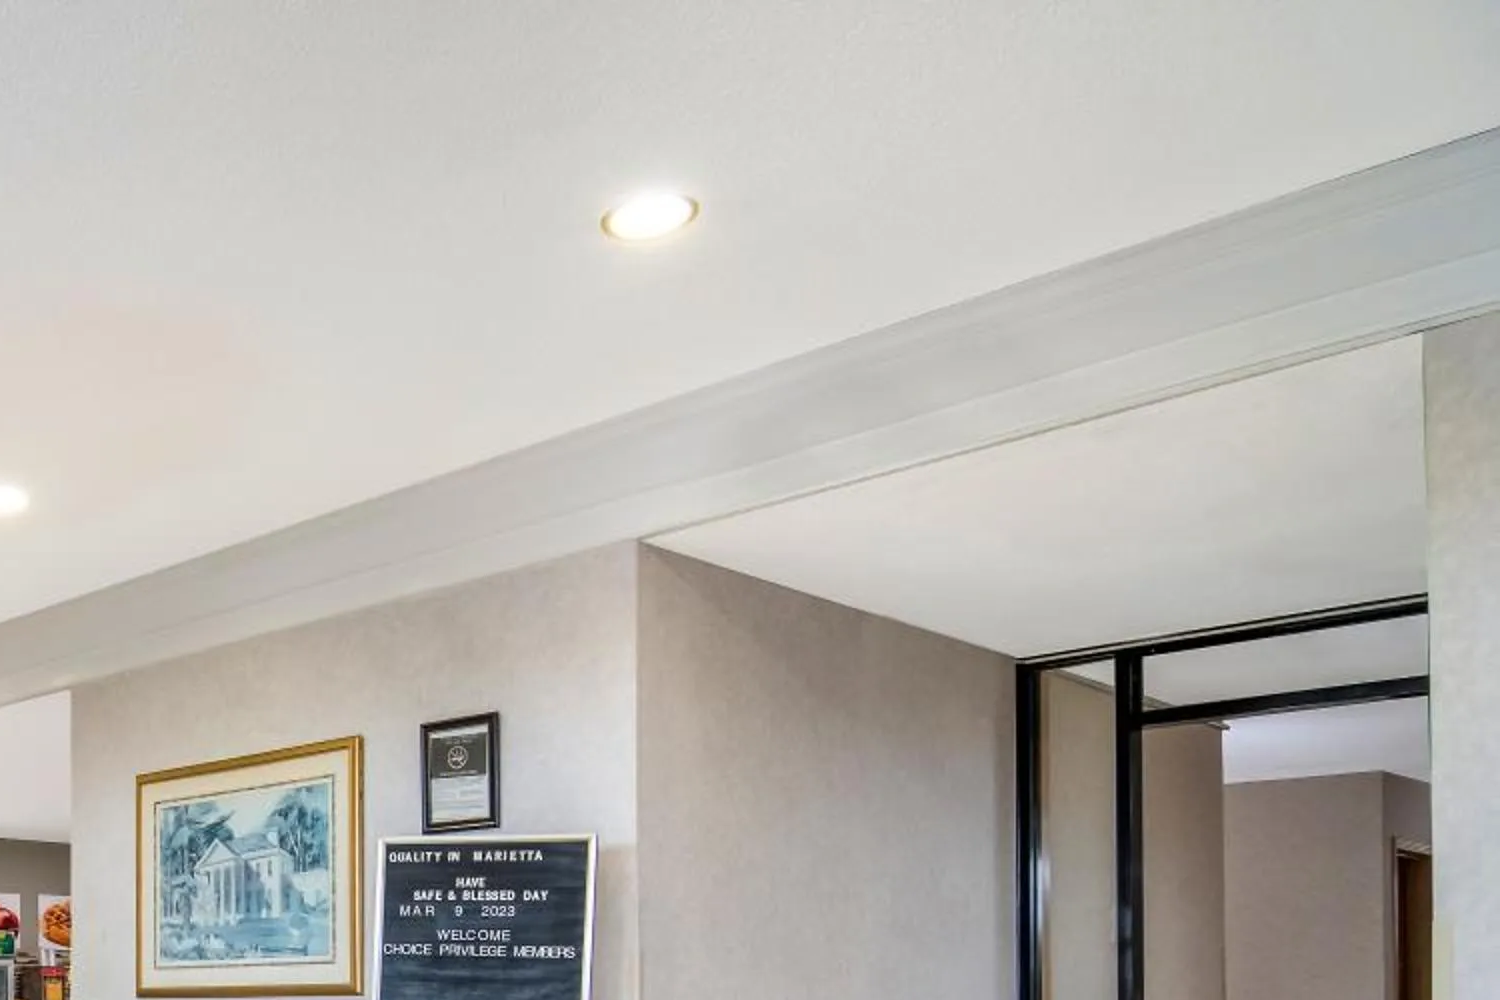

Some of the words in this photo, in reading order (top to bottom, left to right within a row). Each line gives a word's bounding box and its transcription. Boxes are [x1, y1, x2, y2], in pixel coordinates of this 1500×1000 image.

[388, 851, 442, 863] QUALITY
[447, 851, 460, 862] IN
[473, 850, 543, 862] MARIETTA
[455, 877, 487, 888] HAVE
[413, 890, 442, 901] SAFE
[447, 891, 456, 900] &
[462, 890, 516, 901] BLESSED
[523, 890, 549, 901] DAY
[399, 905, 436, 917] MAR
[454, 905, 464, 917] 9
[480, 905, 516, 917] 2023
[436, 929, 511, 941] WELCOME
[383, 944, 433, 956] CHOICE
[439, 945, 507, 958] PRIVILEGE
[512, 945, 576, 959] MEMBERS
